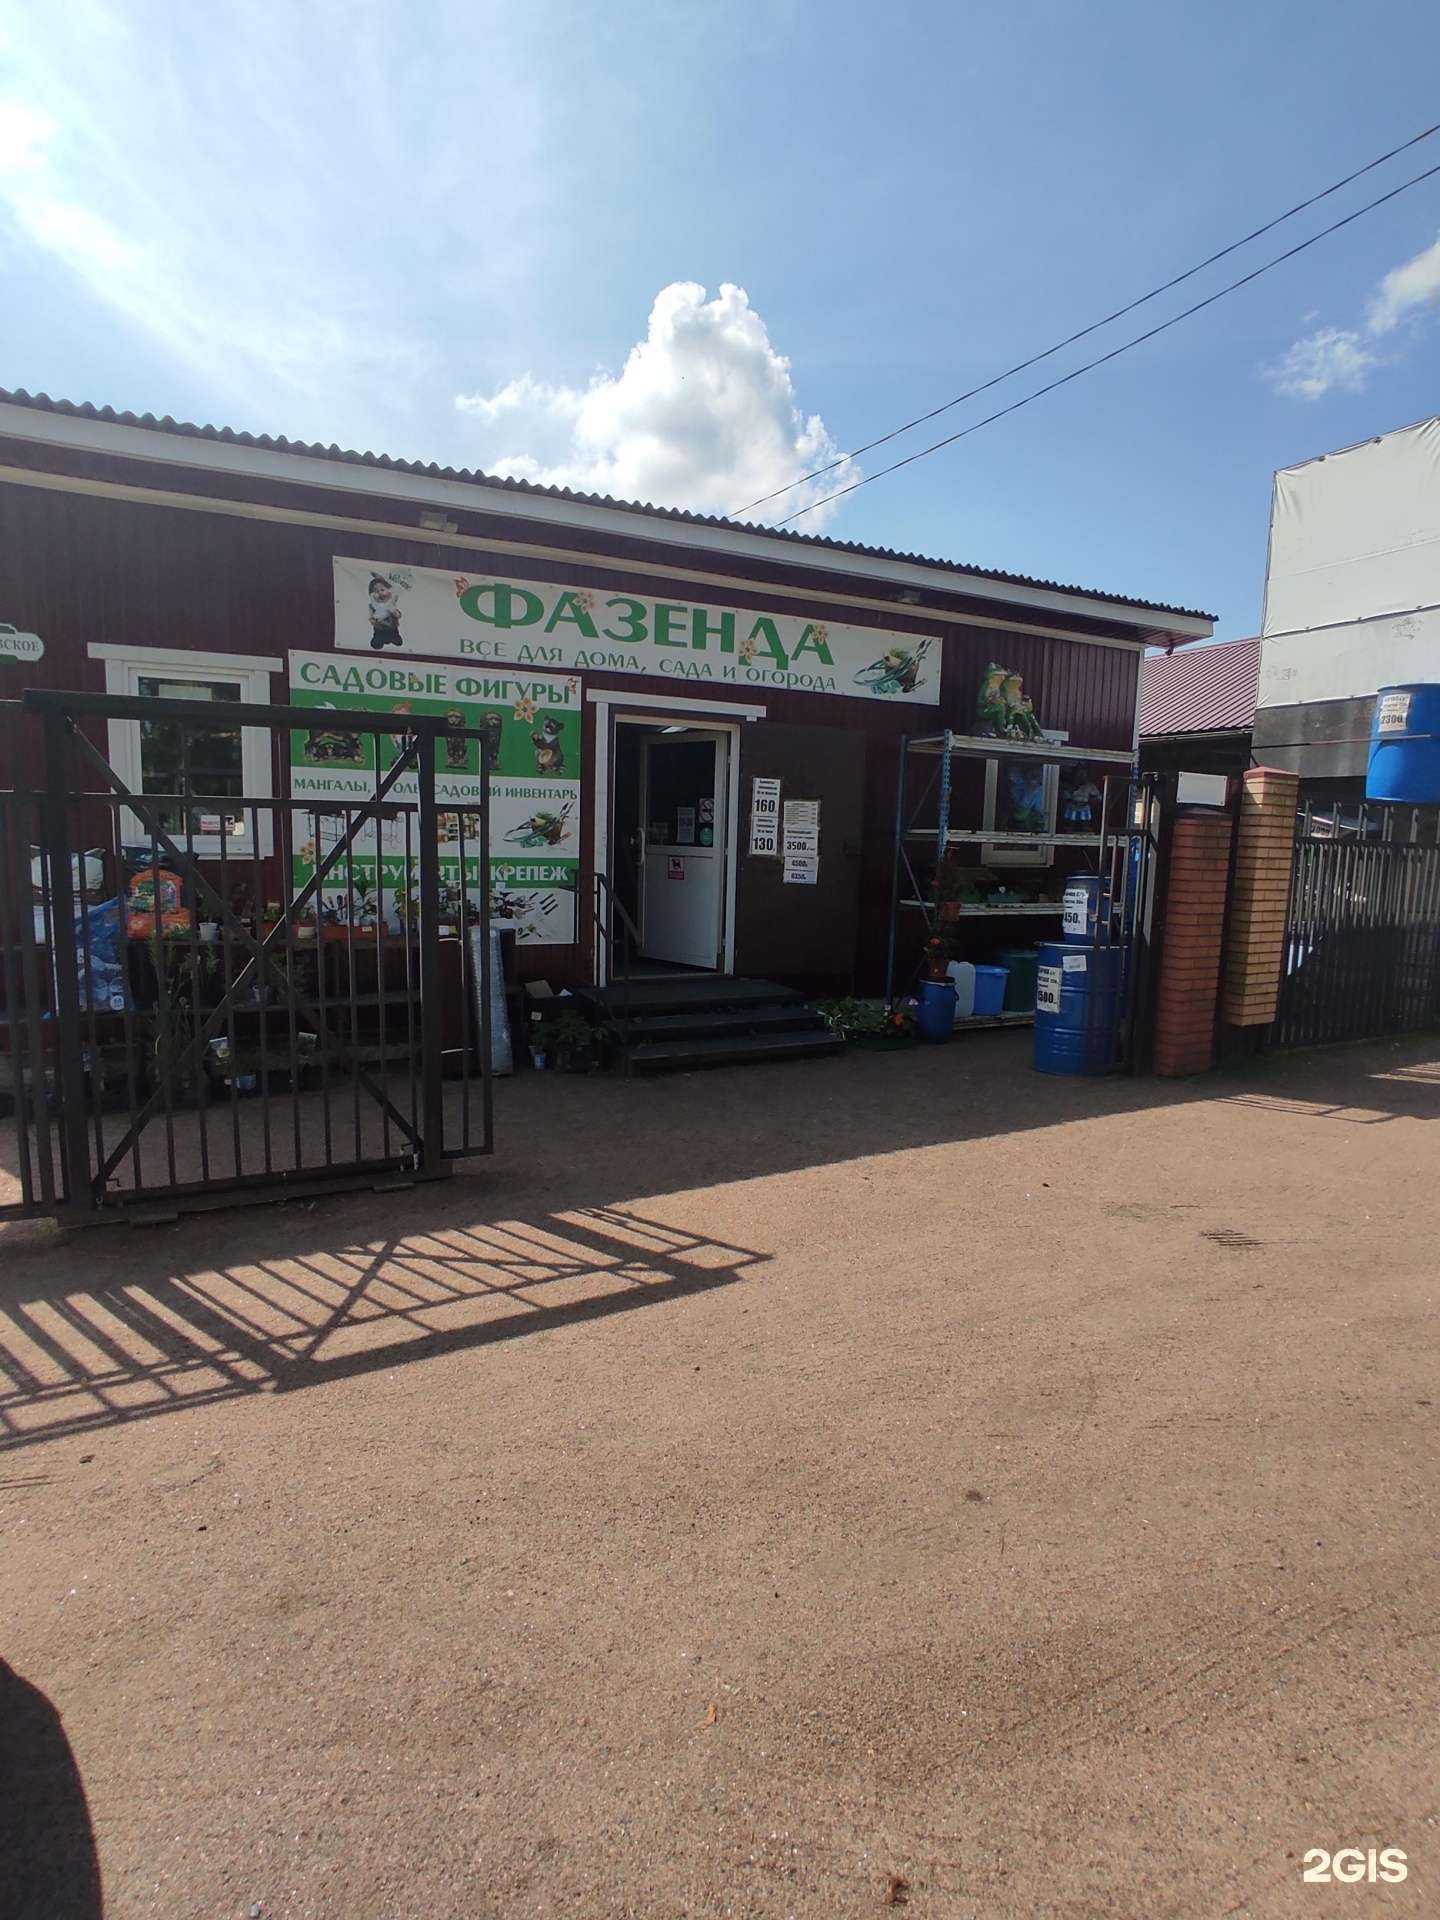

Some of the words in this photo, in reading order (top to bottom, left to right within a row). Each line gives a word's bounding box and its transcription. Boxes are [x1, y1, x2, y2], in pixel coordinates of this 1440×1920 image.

[459, 583, 834, 671] ФАЗЕНДА
[300, 662, 447, 695] САДОВЫЕ
[455, 677, 571, 704] ФИГУРЫ
[460, 638, 507, 658] ВСЕ
[517, 645, 563, 663] ДЛЯ
[574, 650, 647, 673] ДОМА,
[659, 658, 713, 679] САДА
[723, 665, 736, 679] И
[746, 667, 836, 692] ОГОРОДА
[294, 777, 371, 794] МАНГАЛЫ,
[505, 787, 578, 800] ИНВЕНТАРЬ
[491, 864, 569, 881] КРЕПЕЖ
